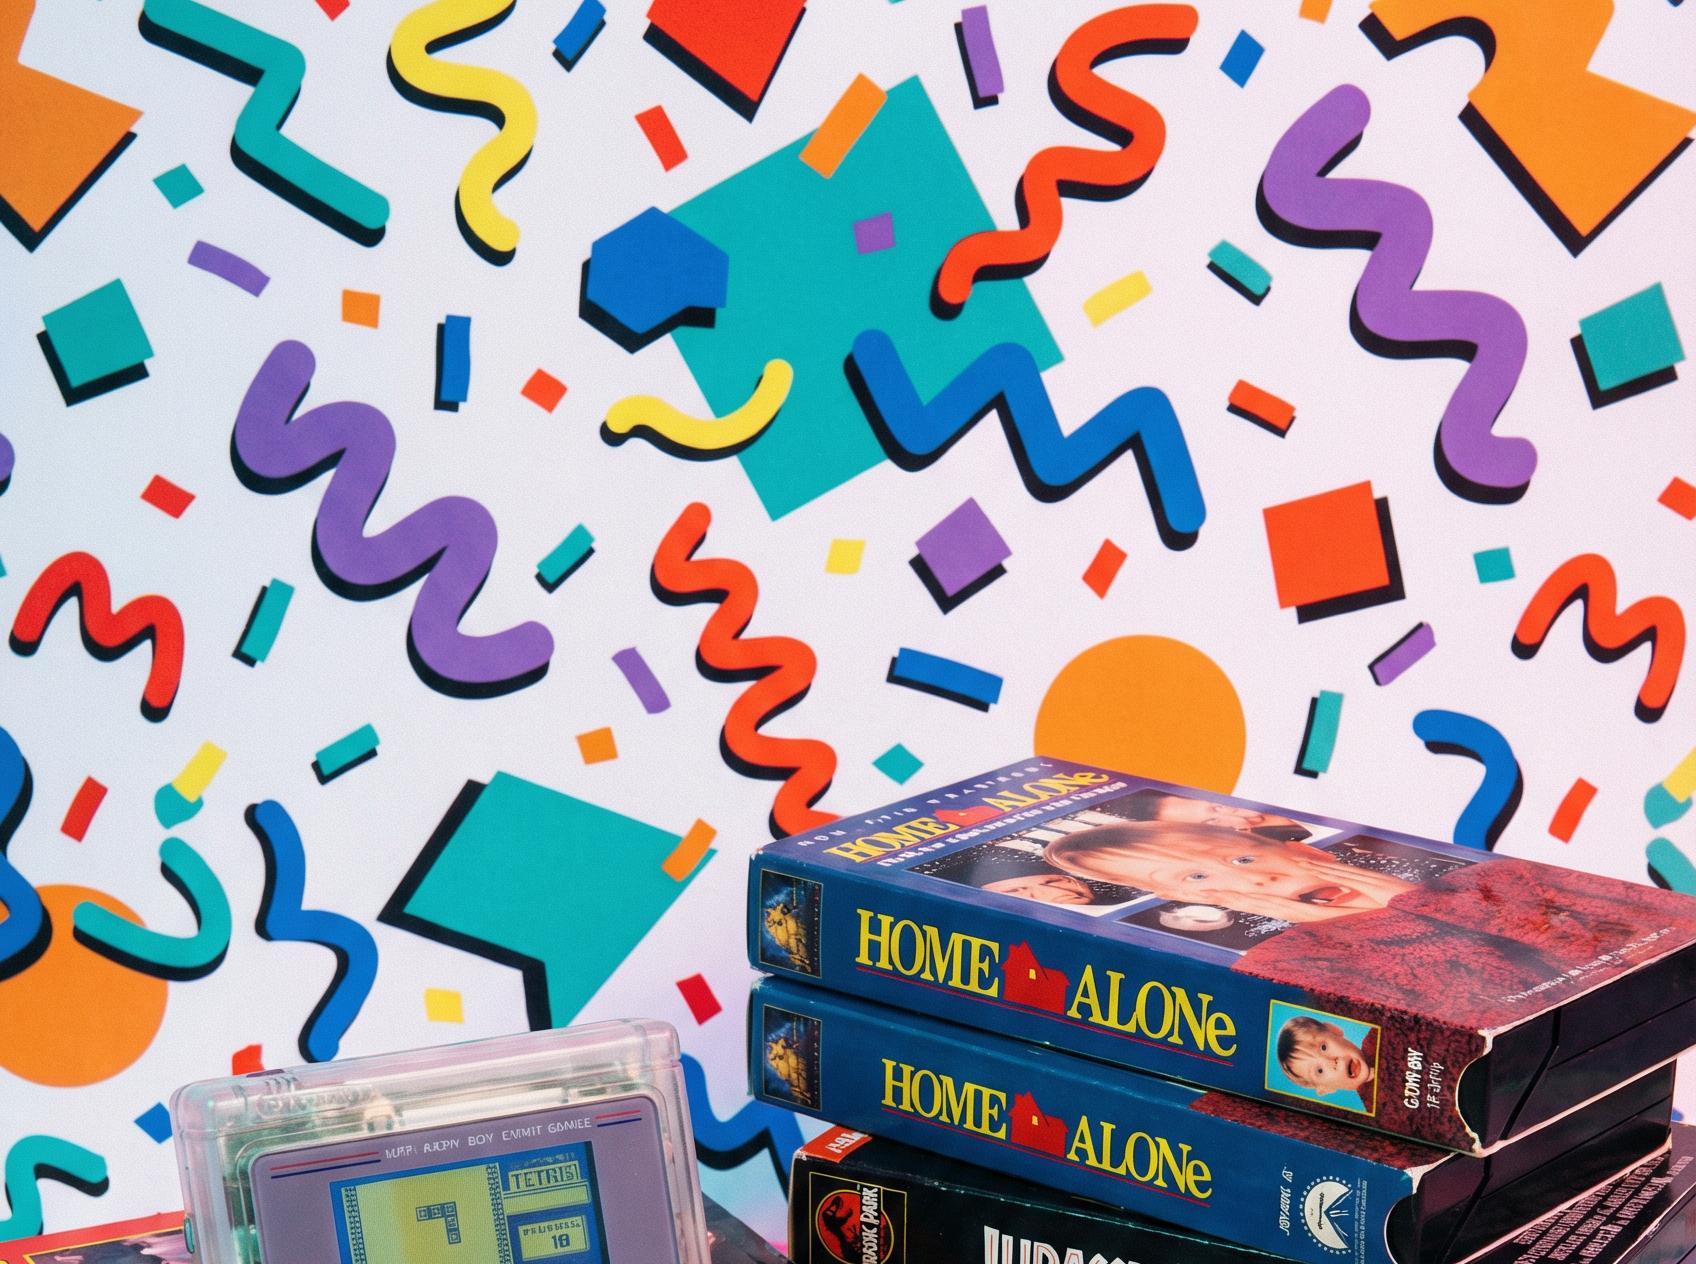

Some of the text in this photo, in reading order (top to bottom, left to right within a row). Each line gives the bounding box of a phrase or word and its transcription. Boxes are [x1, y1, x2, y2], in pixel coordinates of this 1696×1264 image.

[822, 814, 962, 864] HOME
[855, 907, 1001, 999] HOME
[880, 1057, 1009, 1141] HOME
[468, 1133, 495, 1147] BOY
